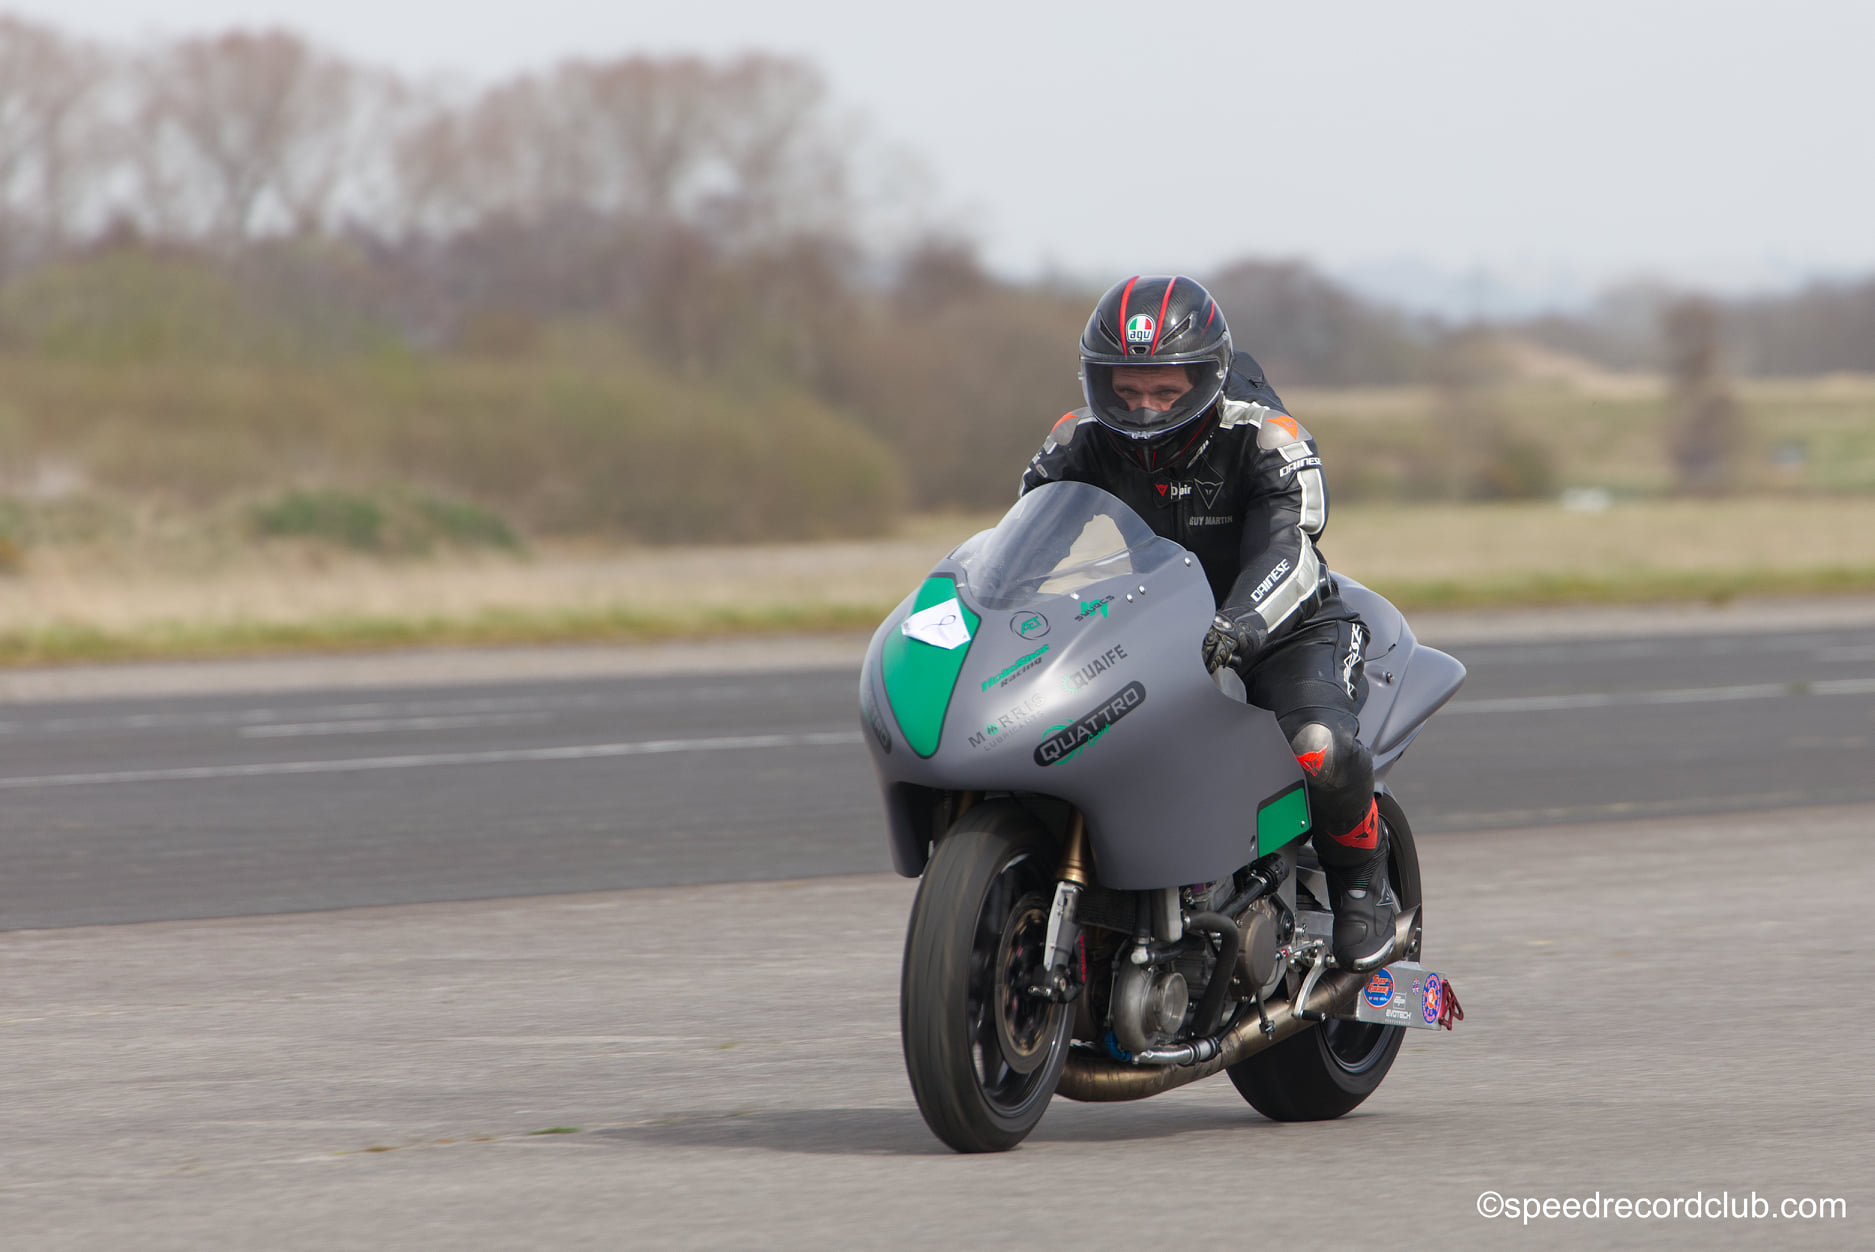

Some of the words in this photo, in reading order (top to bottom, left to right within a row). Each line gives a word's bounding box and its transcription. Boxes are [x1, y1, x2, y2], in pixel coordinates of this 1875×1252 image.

[1130, 331, 1150, 340] agv
[1189, 516, 1205, 526] GUY
[1205, 515, 1233, 526] MARTIN
[1250, 558, 1290, 602] DAINESE
[1021, 615, 1041, 635] AET
[1071, 644, 1128, 690] QUAIFE
[1040, 688, 1139, 762] QUATTRO
